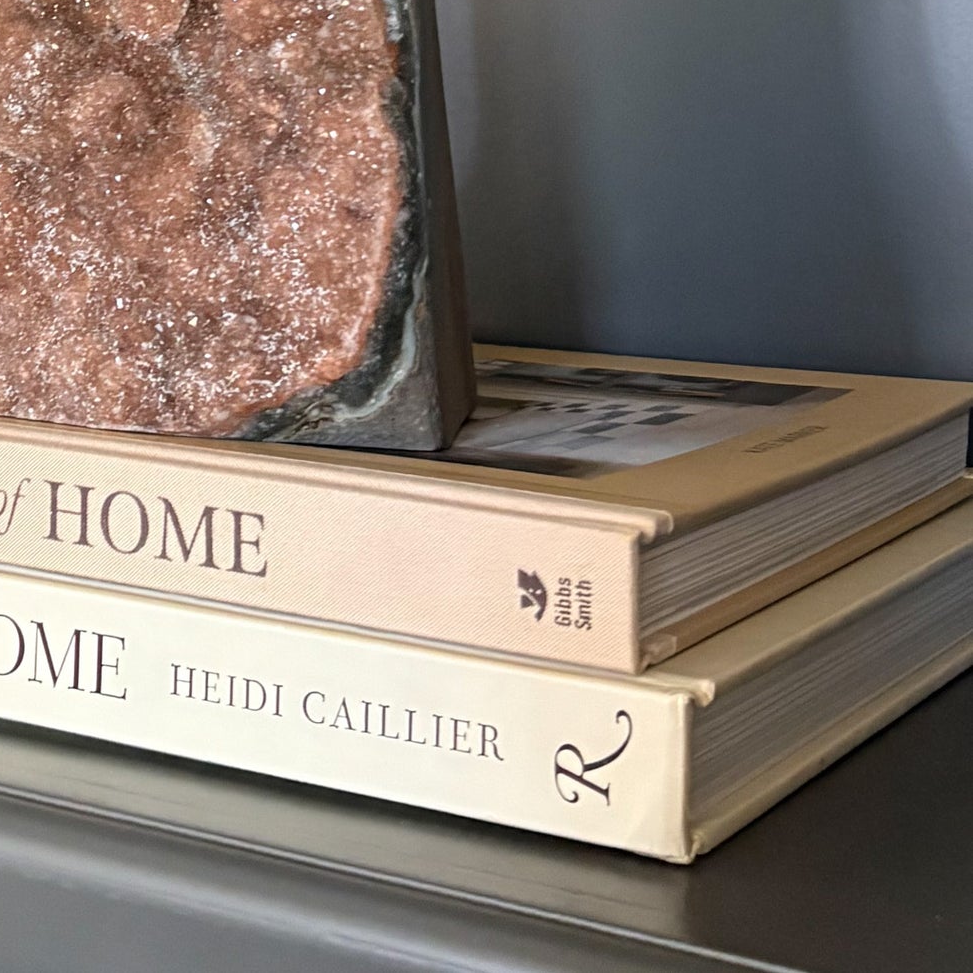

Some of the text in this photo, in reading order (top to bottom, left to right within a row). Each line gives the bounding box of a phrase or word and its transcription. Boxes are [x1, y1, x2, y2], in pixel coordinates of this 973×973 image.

[43, 479, 269, 578] HOME
[554, 577, 572, 627] Gibbs
[574, 580, 593, 631] Smith
[170, 664, 504, 761] HEIDI CAILLIER
